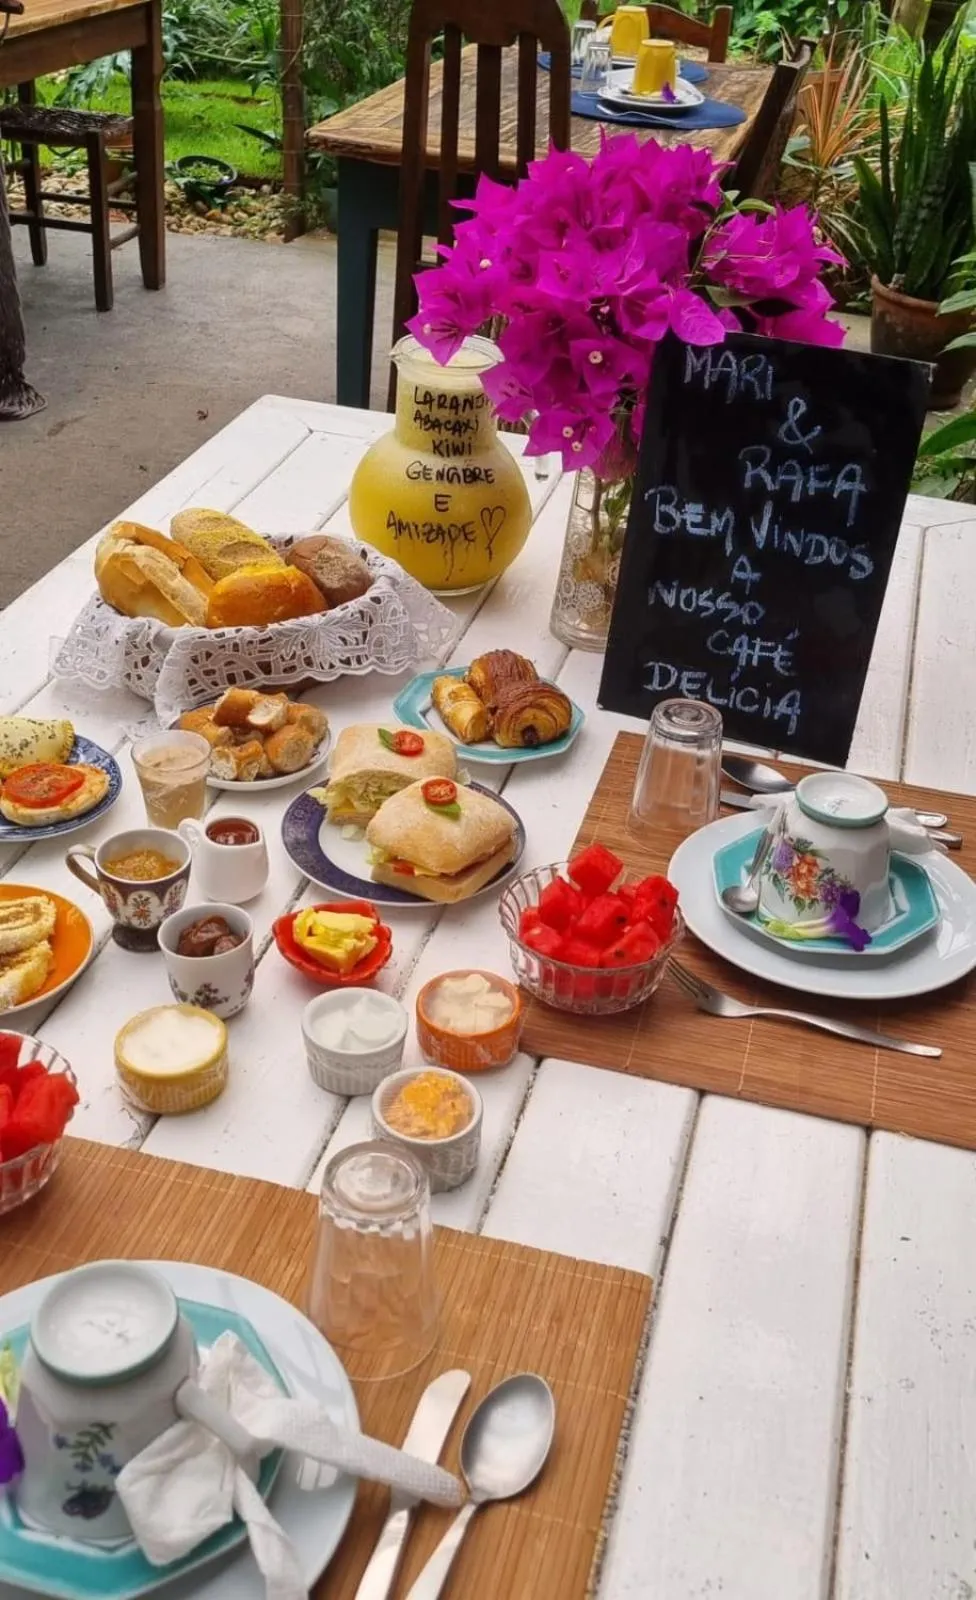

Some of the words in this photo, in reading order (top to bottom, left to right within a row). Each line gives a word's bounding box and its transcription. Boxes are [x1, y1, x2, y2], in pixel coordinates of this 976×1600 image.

[683, 345, 775, 403] MARI
[778, 397, 821, 454] &
[434, 493, 452, 512] E
[739, 446, 868, 527] RAFA
[386, 510, 477, 544] AMIZADE
[644, 485, 735, 556] BEM
[750, 500, 875, 580] VINDOS
[731, 554, 761, 596] A
[648, 581, 766, 625] NOSSO
[706, 628, 799, 680] CAFÉ
[643, 661, 801, 736] DELICIA
